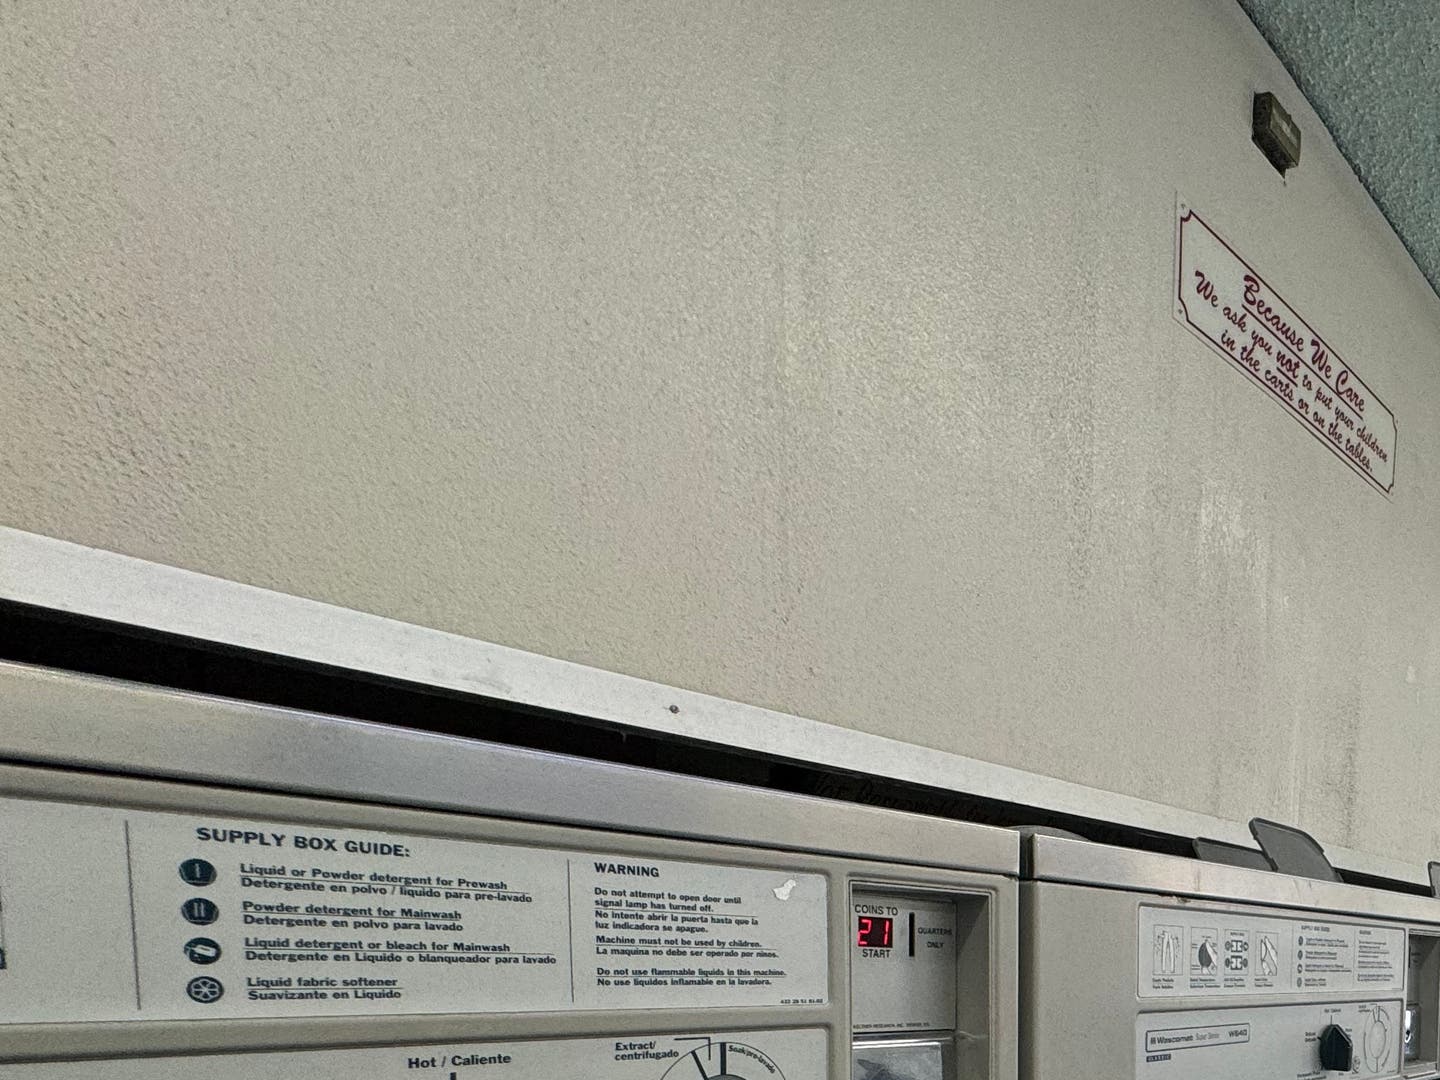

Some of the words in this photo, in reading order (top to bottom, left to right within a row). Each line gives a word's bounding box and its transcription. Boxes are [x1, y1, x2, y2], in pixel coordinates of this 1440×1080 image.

[1243, 274, 1304, 351] Because
[1310, 339, 1332, 379] We
[1335, 370, 1365, 412] Care
[1194, 270, 1219, 308] We
[1223, 306, 1247, 333] ask
[1251, 330, 1272, 356] you
[1276, 349, 1301, 379] not
[1303, 374, 1313, 391] to
[1315, 387, 1333, 410] put
[1335, 405, 1355, 431] your
[1357, 421, 1389, 463] children
[1220, 330, 1236, 351] in
[1240, 342, 1260, 372] the
[1265, 369, 1294, 401] carts
[1297, 397, 1310, 414] or
[1313, 411, 1326, 428] on
[1329, 421, 1343, 444] the
[196, 827, 285, 847] SUPPLY
[294, 836, 337, 851] BOX
[344, 841, 410, 857] GUIDE:
[240, 863, 285, 877] Liquid
[291, 869, 306, 877] or
[311, 868, 365, 880] Powder
[370, 873, 431, 885] detergent
[437, 877, 453, 887] for
[458, 878, 507, 890] Prewash
[594, 862, 660, 878] WARNING
[241, 877, 325, 891] Detergente
[352, 885, 387, 895] polvo
[445, 890, 471, 899] para
[475, 891, 532, 903] pre-lavado
[594, 887, 608, 896] Do
[611, 889, 627, 897] not
[629, 890, 665, 900] attempt
[668, 892, 677, 900] to
[679, 894, 700, 902] open
[703, 894, 721, 903] door
[724, 896, 742, 904] until
[243, 901, 299, 913] Powder
[305, 904, 372, 916] detergent
[377, 907, 395, 916] for
[401, 908, 461, 919] Mainwash
[595, 899, 622, 909] signal
[625, 900, 648, 910] lamp
[650, 902, 666, 910] has
[669, 903, 697, 912] turned
[699, 904, 714, 912] off.
[854, 904, 884, 915] COINS
[886, 906, 898, 916] TO
[243, 915, 326, 927] Detergente
[332, 920, 348, 928] en
[353, 920, 388, 929] polvo
[393, 923, 421, 931] para
[425, 922, 463, 931] lavado
[595, 910, 608, 919] No
[611, 911, 644, 920] intente
[647, 913, 668, 921] abrir
[671, 914, 679, 922] la
[681, 915, 709, 924] puerta
[711, 916, 733, 925] hasta
[734, 918, 750, 926] que
[595, 920, 609, 929] luz
[612, 921, 660, 931] indicadora
[675, 926, 709, 934] apague.
[857, 919, 890, 945] 21
[917, 927, 953, 935] QUARTERS
[245, 937, 290, 949] Liquid
[295, 939, 363, 951] detergent
[386, 941, 427, 950] bleach
[432, 942, 449, 950] for
[453, 942, 510, 952] Mainwash
[595, 935, 636, 945] Machine
[639, 937, 662, 946] must
[664, 938, 678, 946] not
[681, 938, 692, 946] be
[694, 938, 714, 947] used
[716, 939, 726, 948] by
[728, 939, 762, 948] children.
[245, 951, 328, 962] Detergente
[419, 953, 490, 964] blanqueador
[495, 956, 519, 964] para
[523, 955, 556, 964] lavado
[862, 949, 891, 958] START
[597, 967, 610, 976] Do
[613, 968, 629, 976] not
[651, 967, 696, 976] flammable
[698, 968, 725, 977] liquids
[727, 968, 735, 976] in
[737, 968, 752, 976] this
[753, 969, 787, 977] machine.
[246, 977, 292, 988] Liquid
[297, 977, 337, 987] fabric
[342, 977, 398, 987] softener
[248, 991, 328, 1000] Suavizante
[332, 992, 350, 1000] en
[614, 1041, 657, 1051] Extract/
[407, 1056, 437, 1069] Hot
[451, 1054, 511, 1066] Caliente
[614, 1049, 680, 1061] centrifugado
